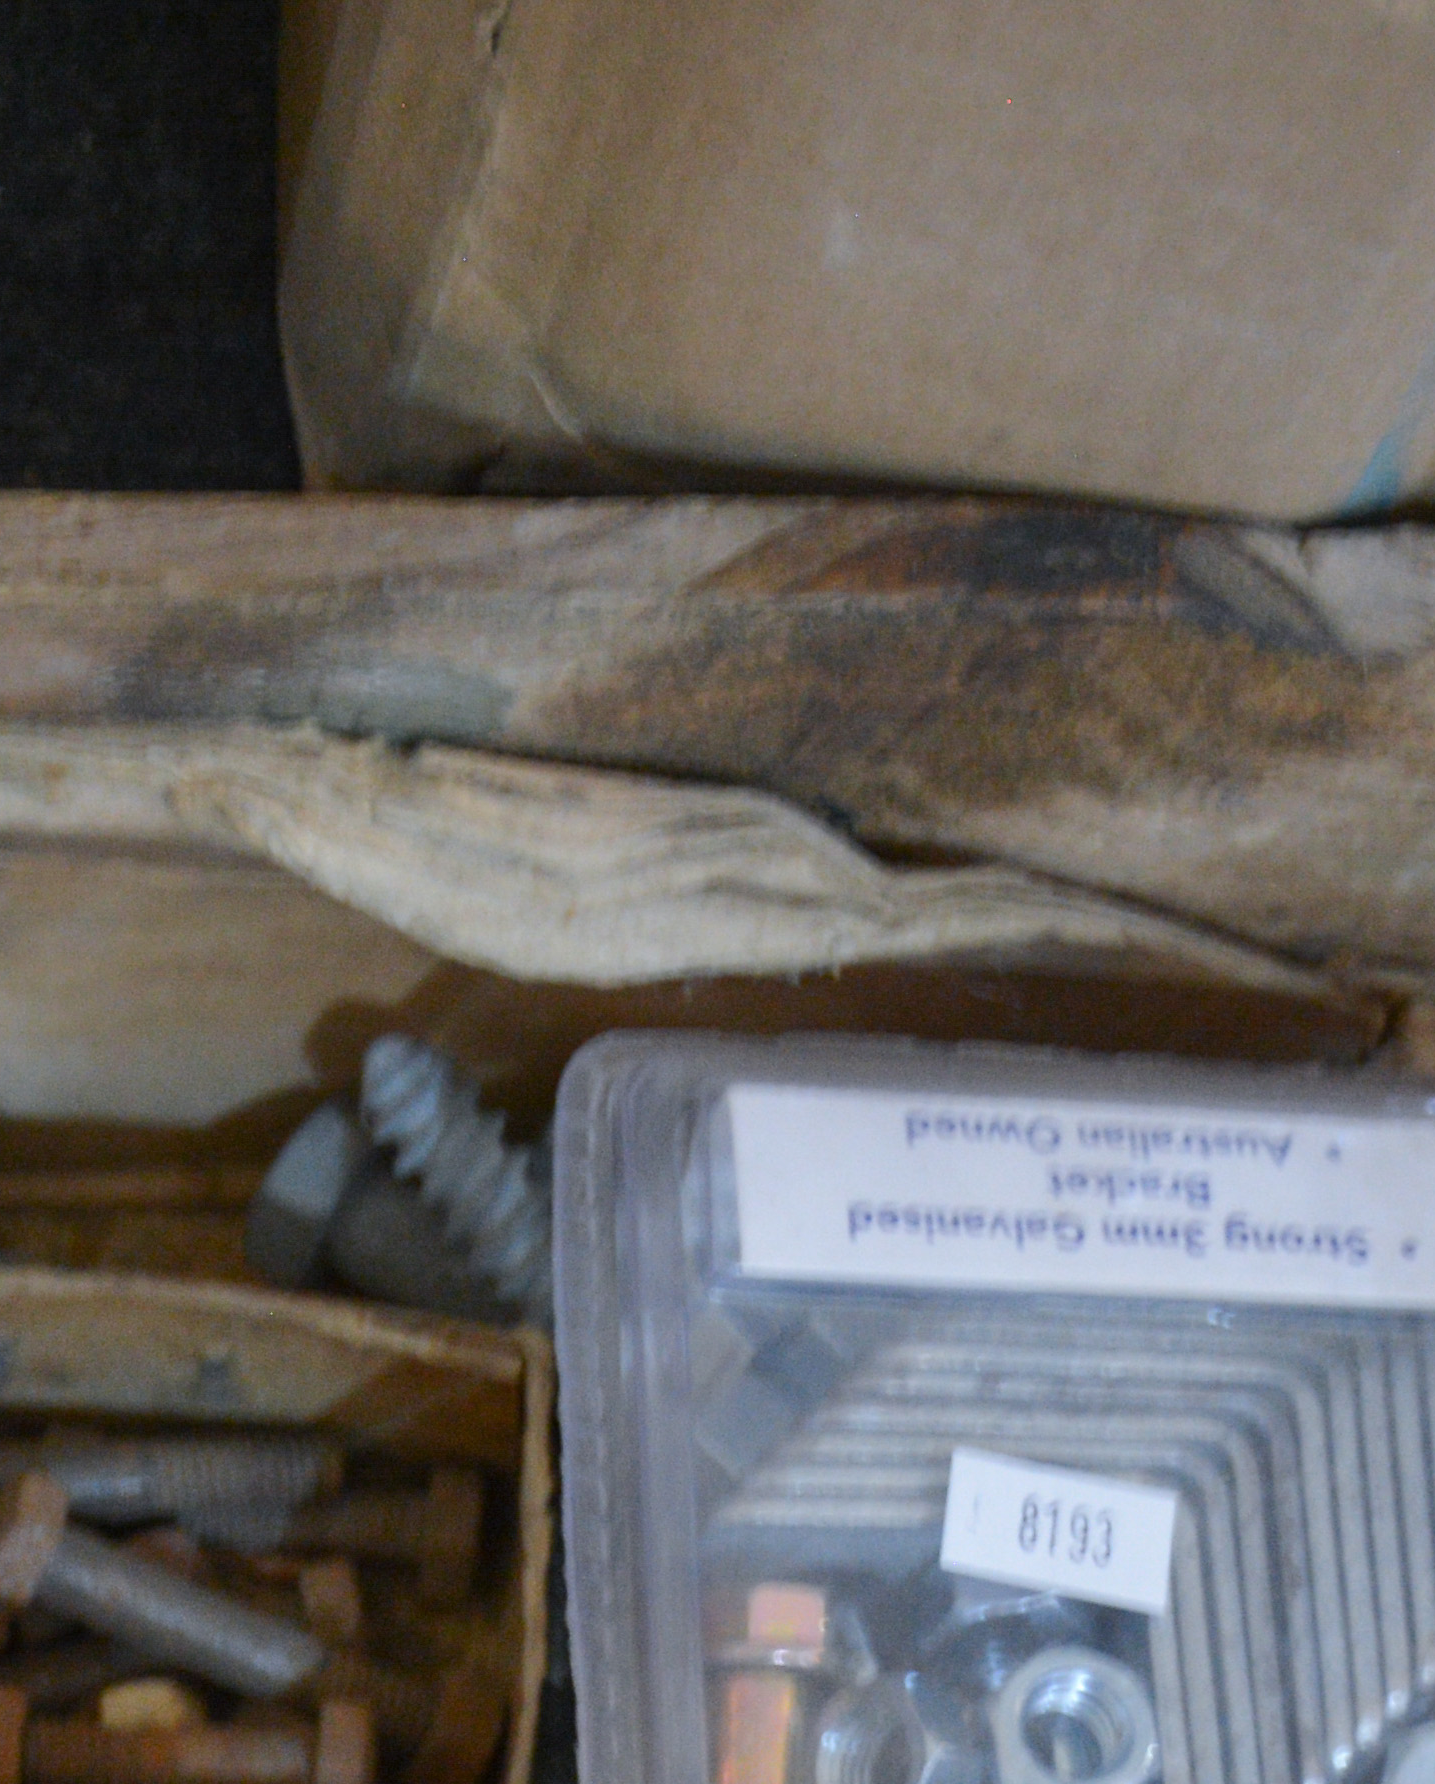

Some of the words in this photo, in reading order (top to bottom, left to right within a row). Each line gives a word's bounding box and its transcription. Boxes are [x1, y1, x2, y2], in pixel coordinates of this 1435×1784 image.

[904, 1112, 1063, 1156] Owned
[1076, 1123, 1293, 1168] Australian
[1045, 1168, 1212, 1213] Bracket
[845, 1202, 1085, 1253] Galvanised
[1100, 1217, 1207, 1259] 3mm
[1224, 1214, 1370, 1268] Strong
[1018, 1491, 1113, 1569] 8193
